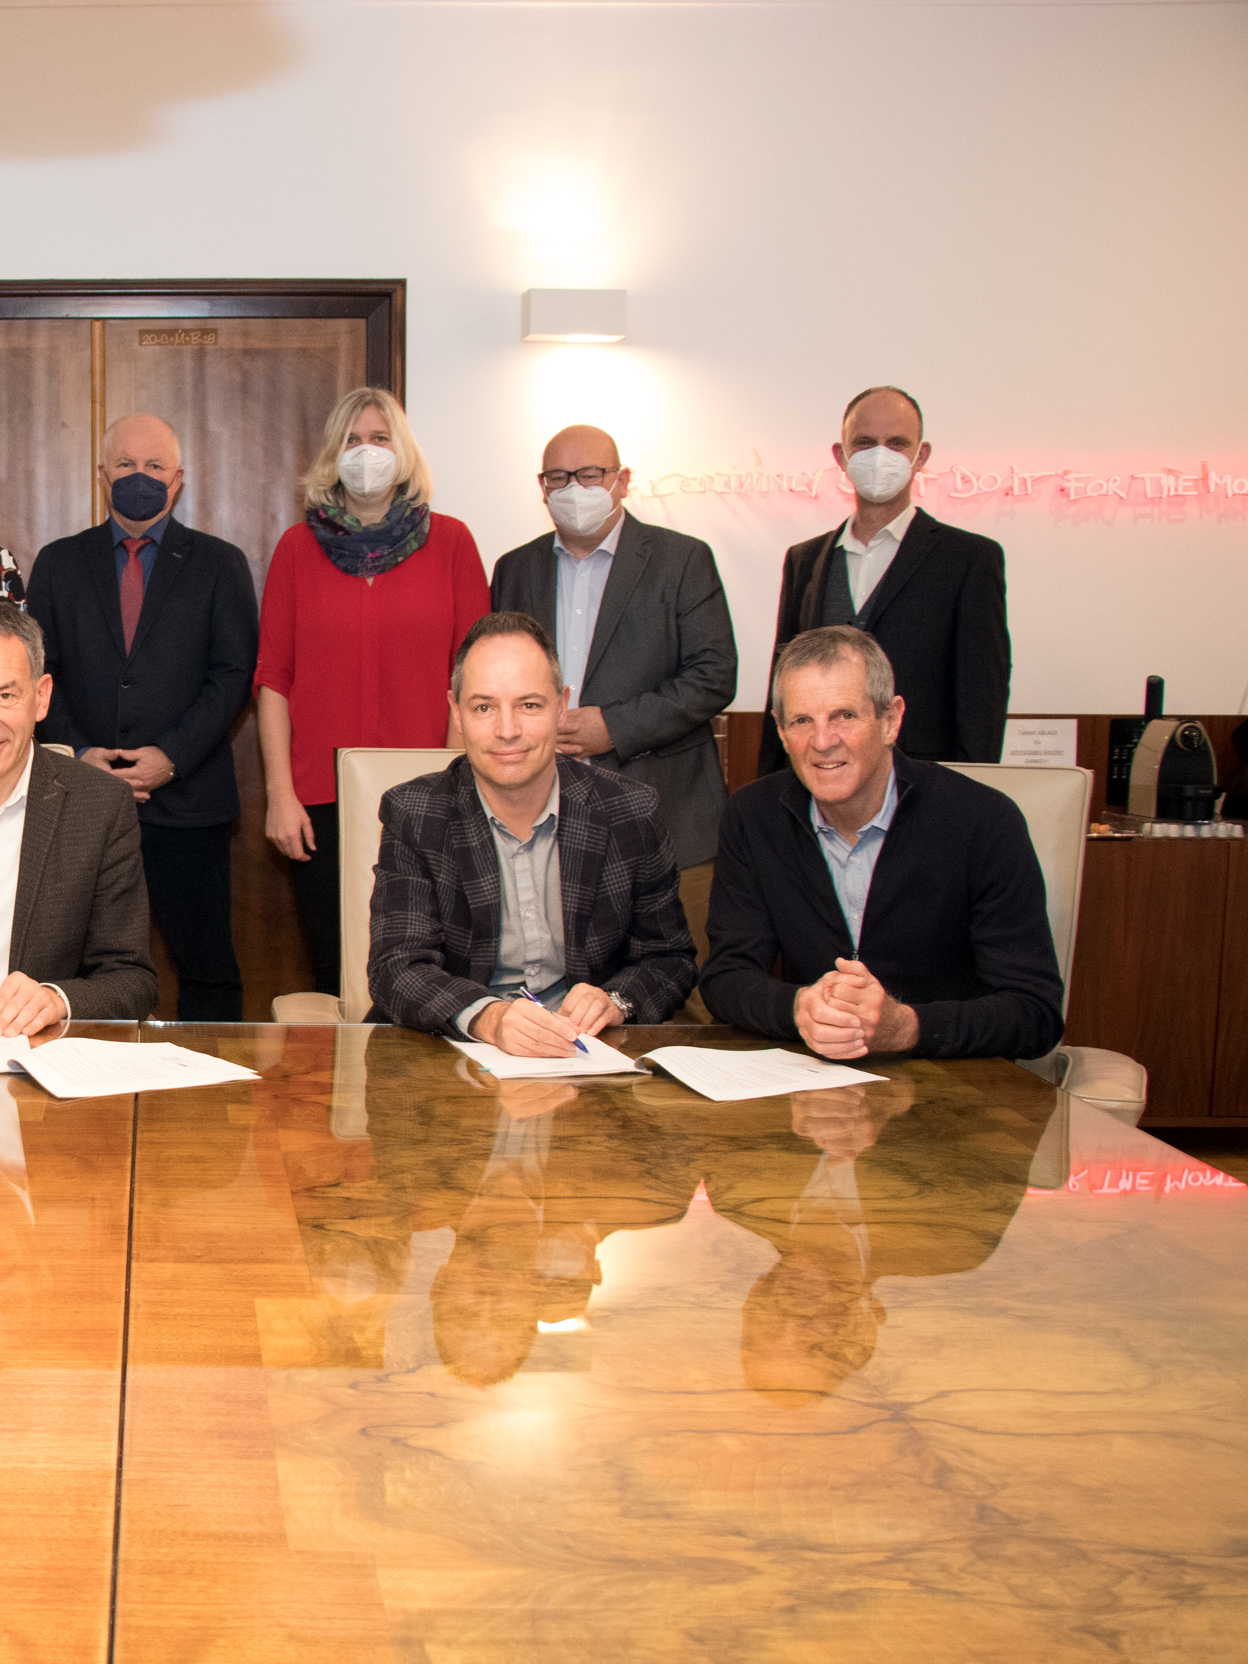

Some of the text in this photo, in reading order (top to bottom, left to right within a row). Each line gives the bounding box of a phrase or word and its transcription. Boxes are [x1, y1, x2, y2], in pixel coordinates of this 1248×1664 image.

[949, 463, 1002, 498] DO
[1010, 464, 1056, 496] IT
[1063, 472, 1127, 501] FOR
[1133, 472, 1198, 498] THE
